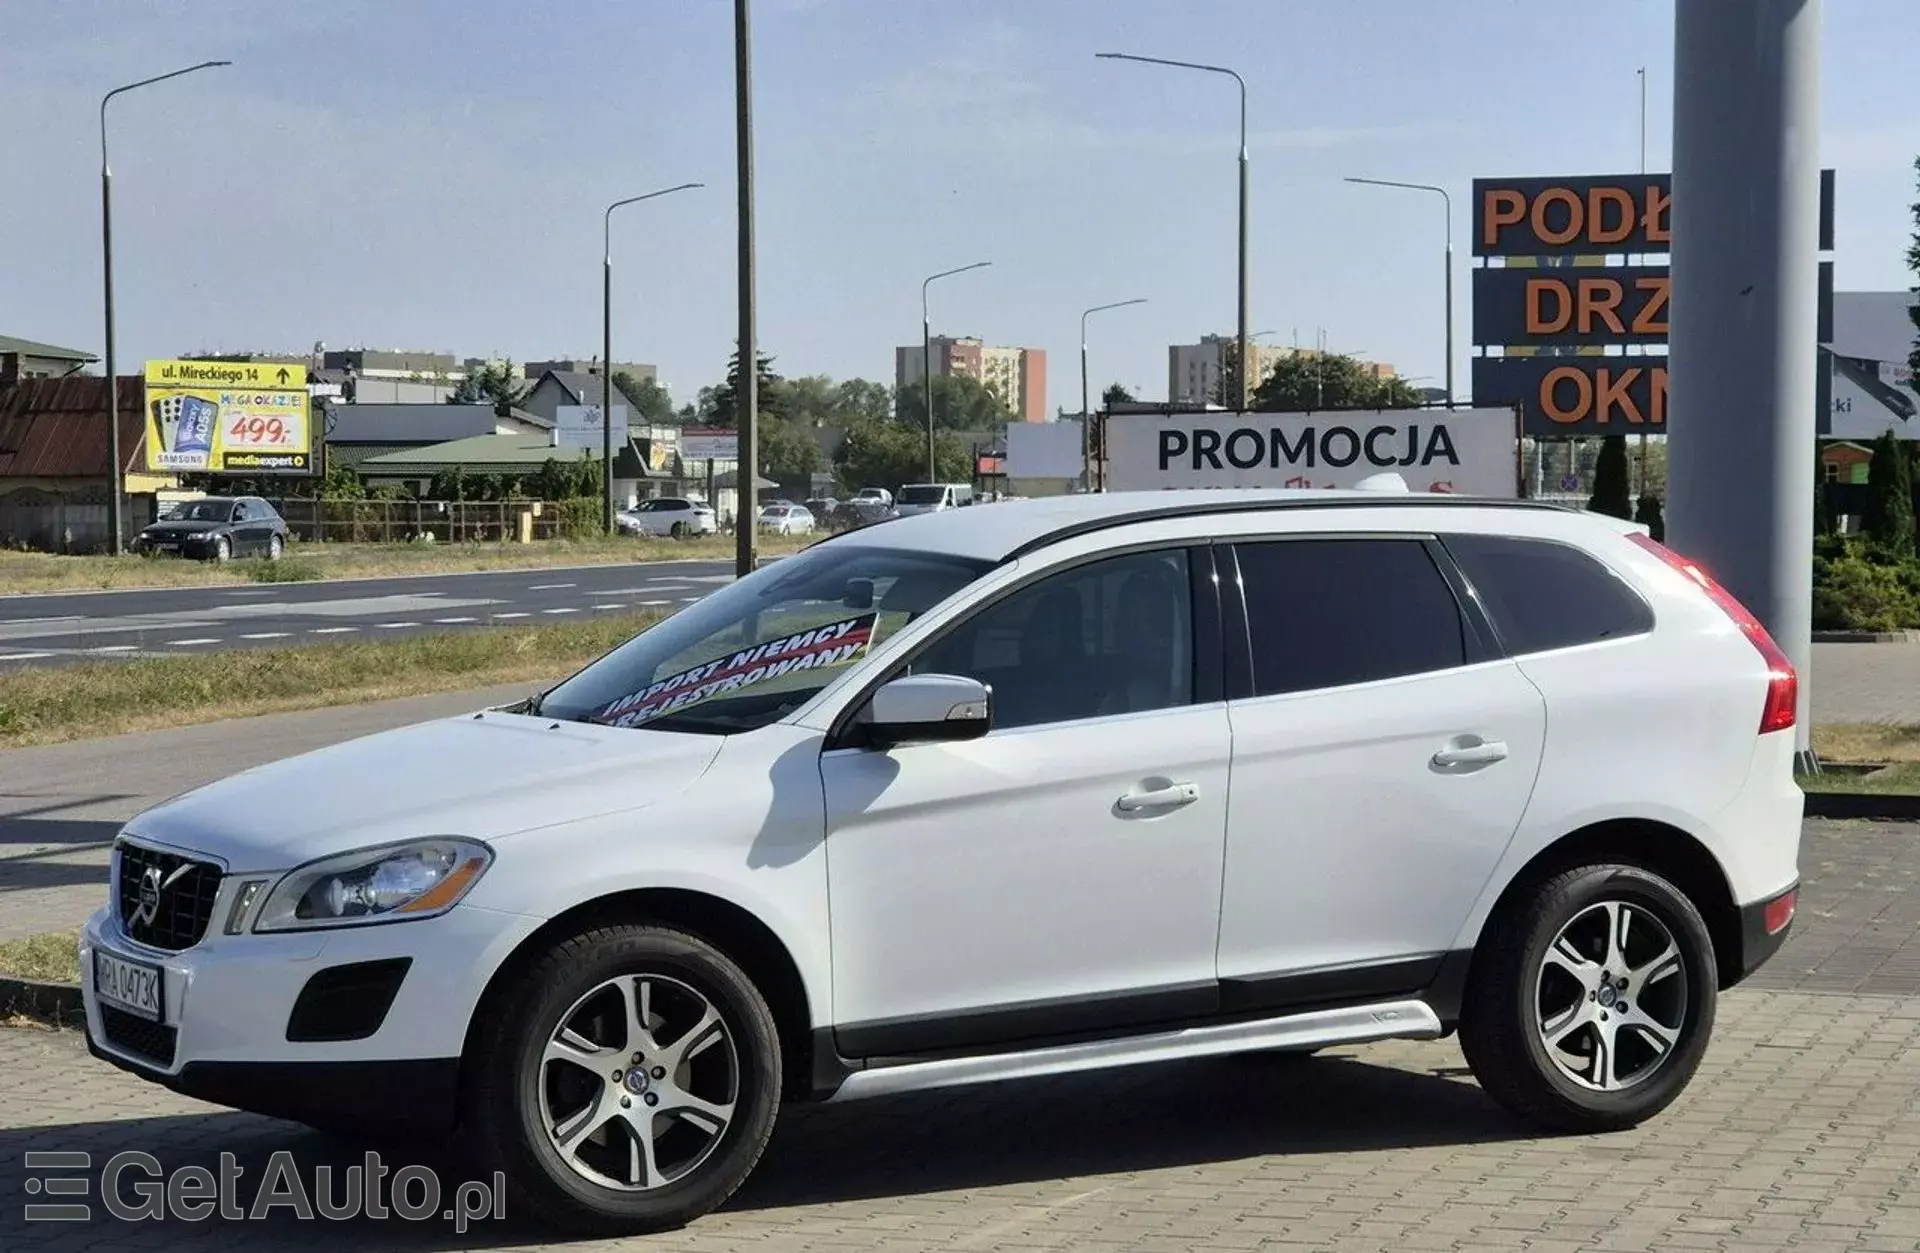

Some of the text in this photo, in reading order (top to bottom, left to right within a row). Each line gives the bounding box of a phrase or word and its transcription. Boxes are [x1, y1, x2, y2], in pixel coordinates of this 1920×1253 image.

[162, 365, 258, 383] ul. Mireckiego 14
[1831, 397, 1852, 413] ki
[1158, 424, 1460, 471] PROMOCJA
[157, 454, 203, 463] SAMSUNG
[228, 454, 293, 467] mediaexpert
[602, 619, 857, 717] IMPORT NIEMCY
[608, 641, 863, 728] REJESTROWANY
